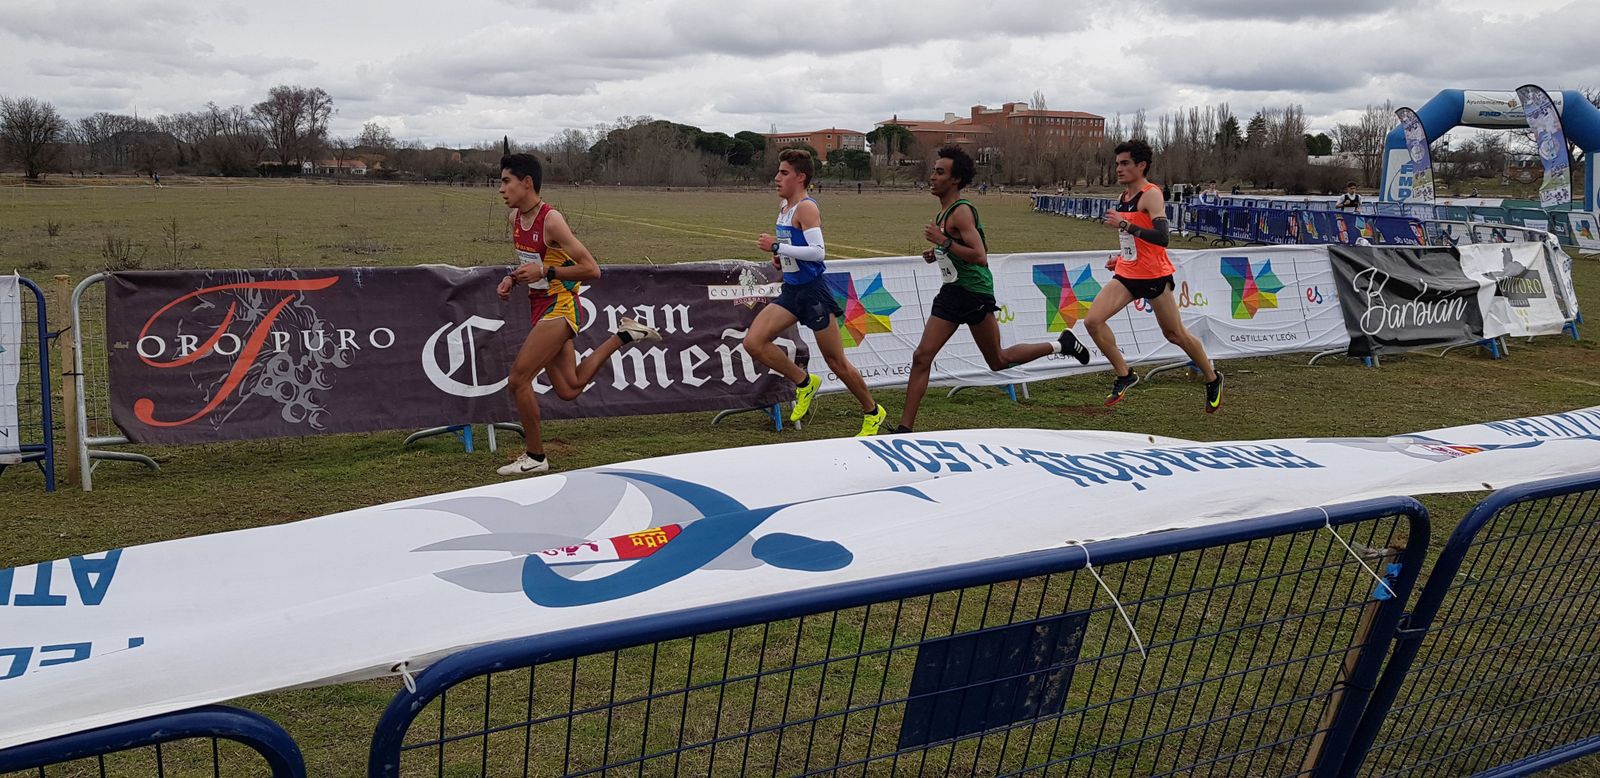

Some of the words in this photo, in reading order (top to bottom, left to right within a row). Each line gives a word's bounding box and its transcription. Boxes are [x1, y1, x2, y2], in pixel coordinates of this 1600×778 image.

[1353, 266, 1467, 335] Barbián
[136, 333, 241, 358] ORO
[271, 327, 396, 353] PURO
[1230, 334, 1268, 343] CASTILLA
[1269, 334, 1275, 342] Y
[1276, 331, 1297, 342] LEÓN
[881, 367, 889, 376] Y
[892, 363, 912, 376] LEÓ
